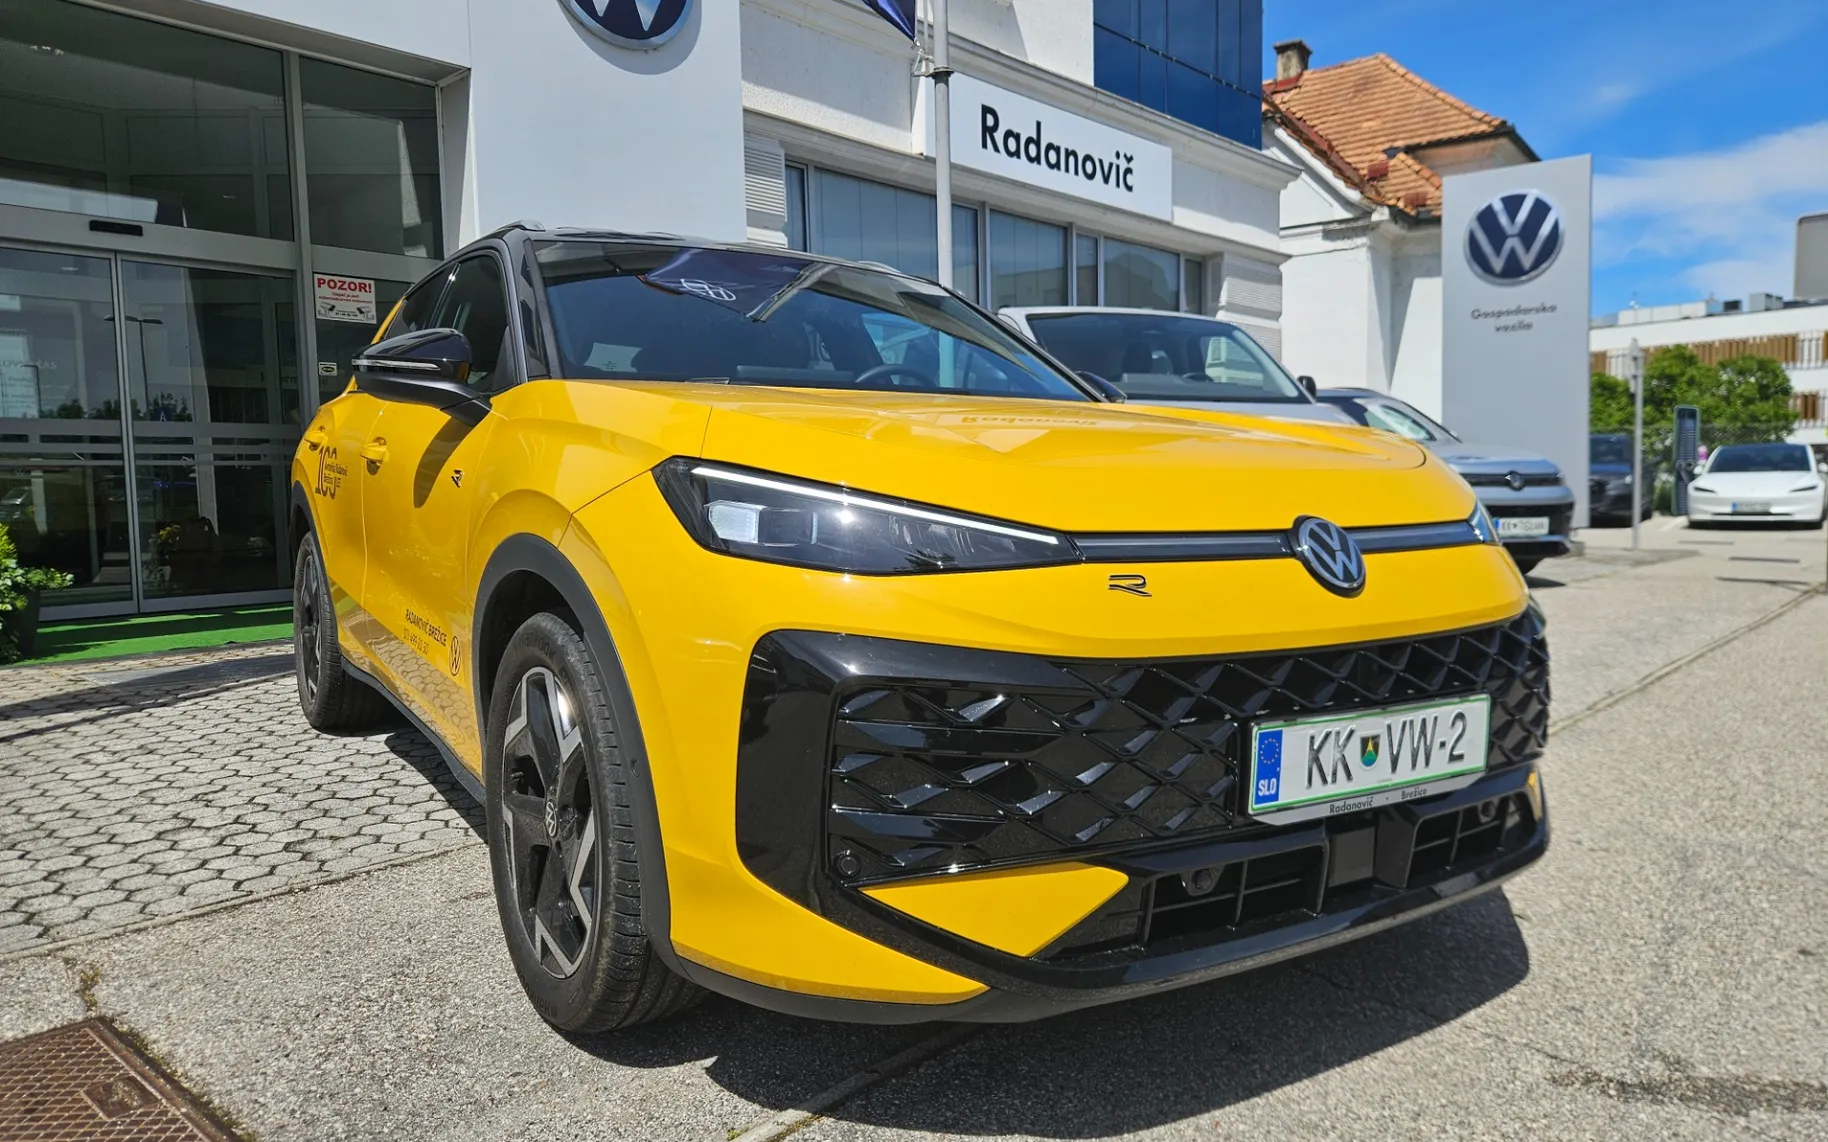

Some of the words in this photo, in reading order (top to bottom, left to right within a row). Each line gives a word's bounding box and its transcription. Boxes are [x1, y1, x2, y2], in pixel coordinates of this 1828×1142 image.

[981, 104, 1134, 192] Radanovič
[317, 277, 372, 293] POZOR!
[1305, 726, 1357, 788] KK
[1386, 711, 1468, 774] VW-2
[1258, 778, 1277, 797] SLO
[1329, 796, 1373, 814] Radanovič
[1401, 786, 1428, 800] Brežice
